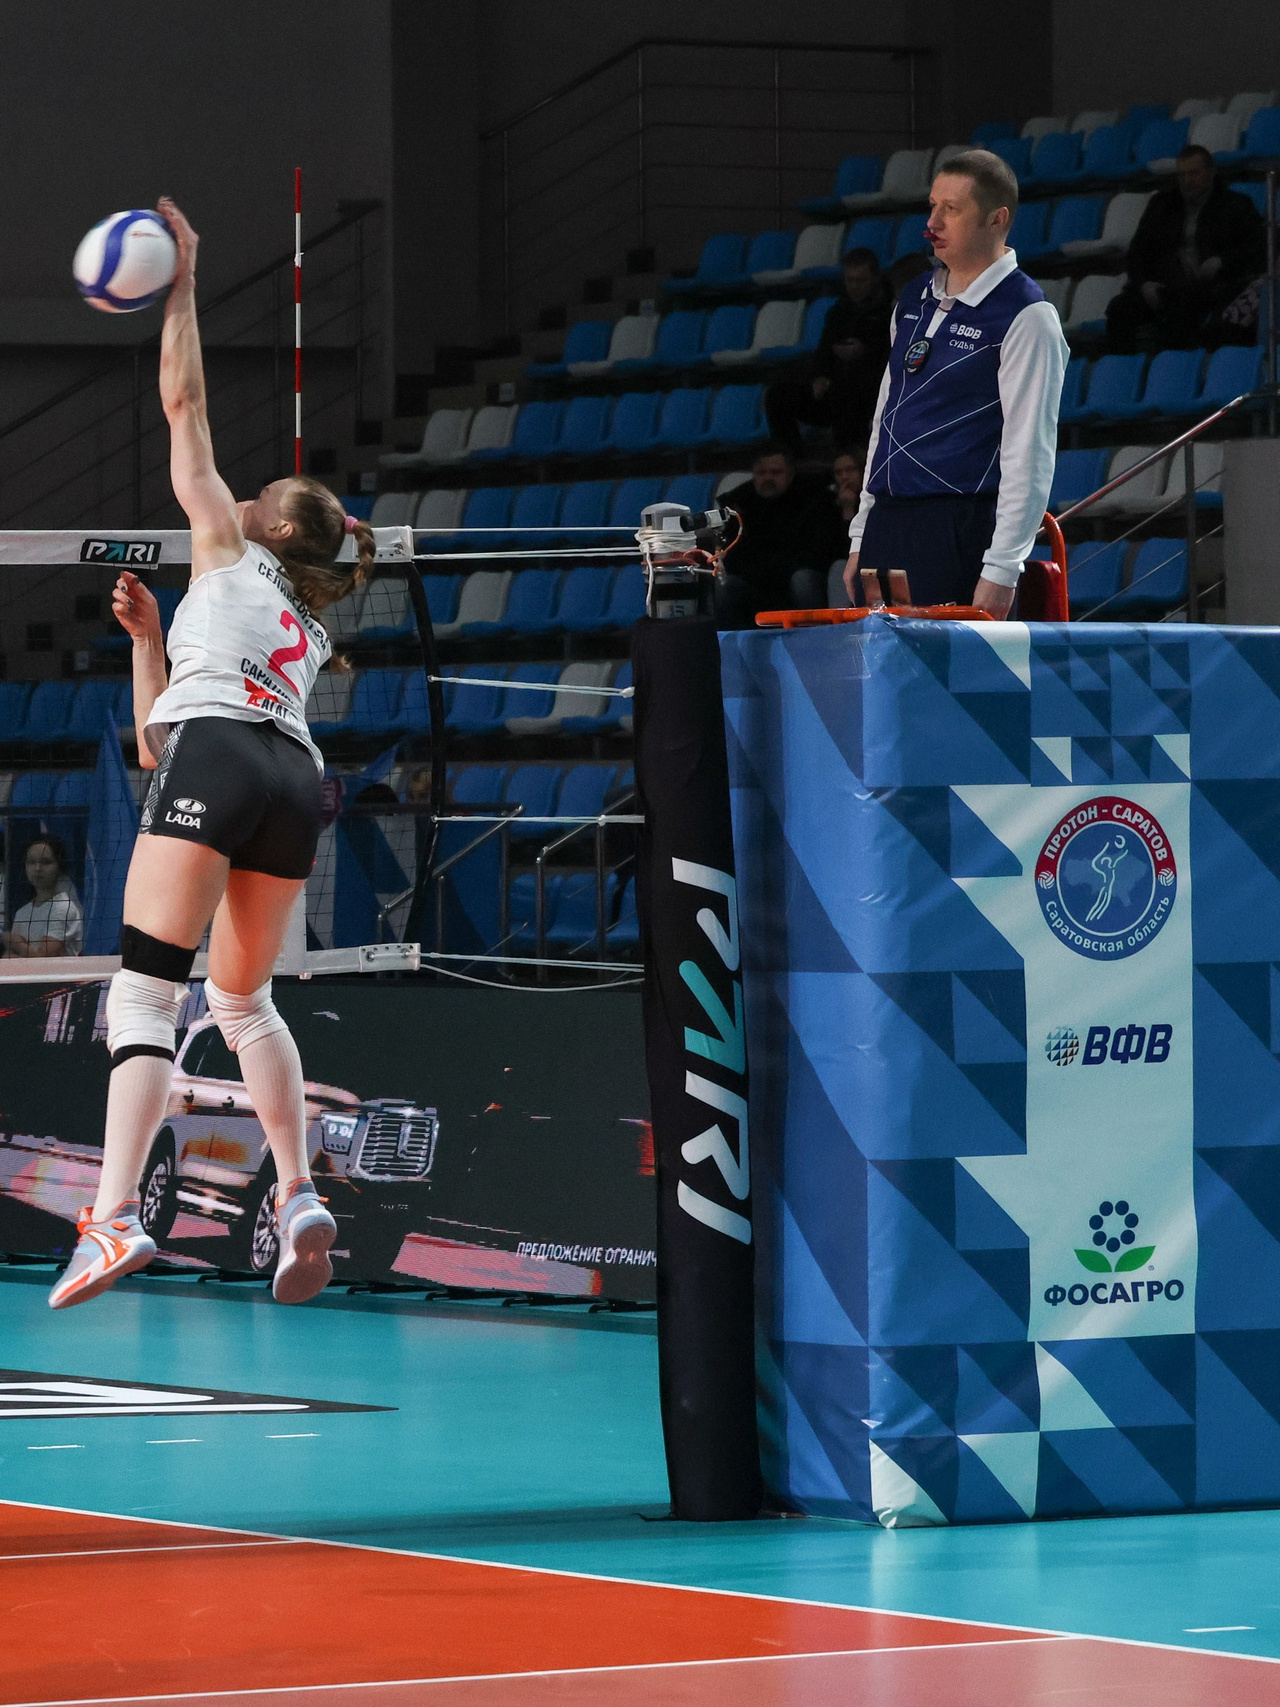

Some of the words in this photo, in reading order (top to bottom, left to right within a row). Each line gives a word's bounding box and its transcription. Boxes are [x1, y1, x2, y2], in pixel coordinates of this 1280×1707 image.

[956, 324, 982, 340] ВФВ
[85, 541, 156, 563] PARI
[267, 610, 308, 696] 2
[165, 810, 202, 829] LADA
[1043, 804, 1098, 860] ПРОТОН
[1111, 803, 1168, 862] САРАТОВ
[1045, 900, 1124, 953] Саратовская
[1127, 896, 1170, 947] область
[670, 856, 753, 1246] PARI
[1081, 1023, 1174, 1066] ВФВ
[516, 1241, 604, 1263] ПРЕДЛОЖЕНИЕ
[1043, 1278, 1185, 1307] ФОСАГРО
